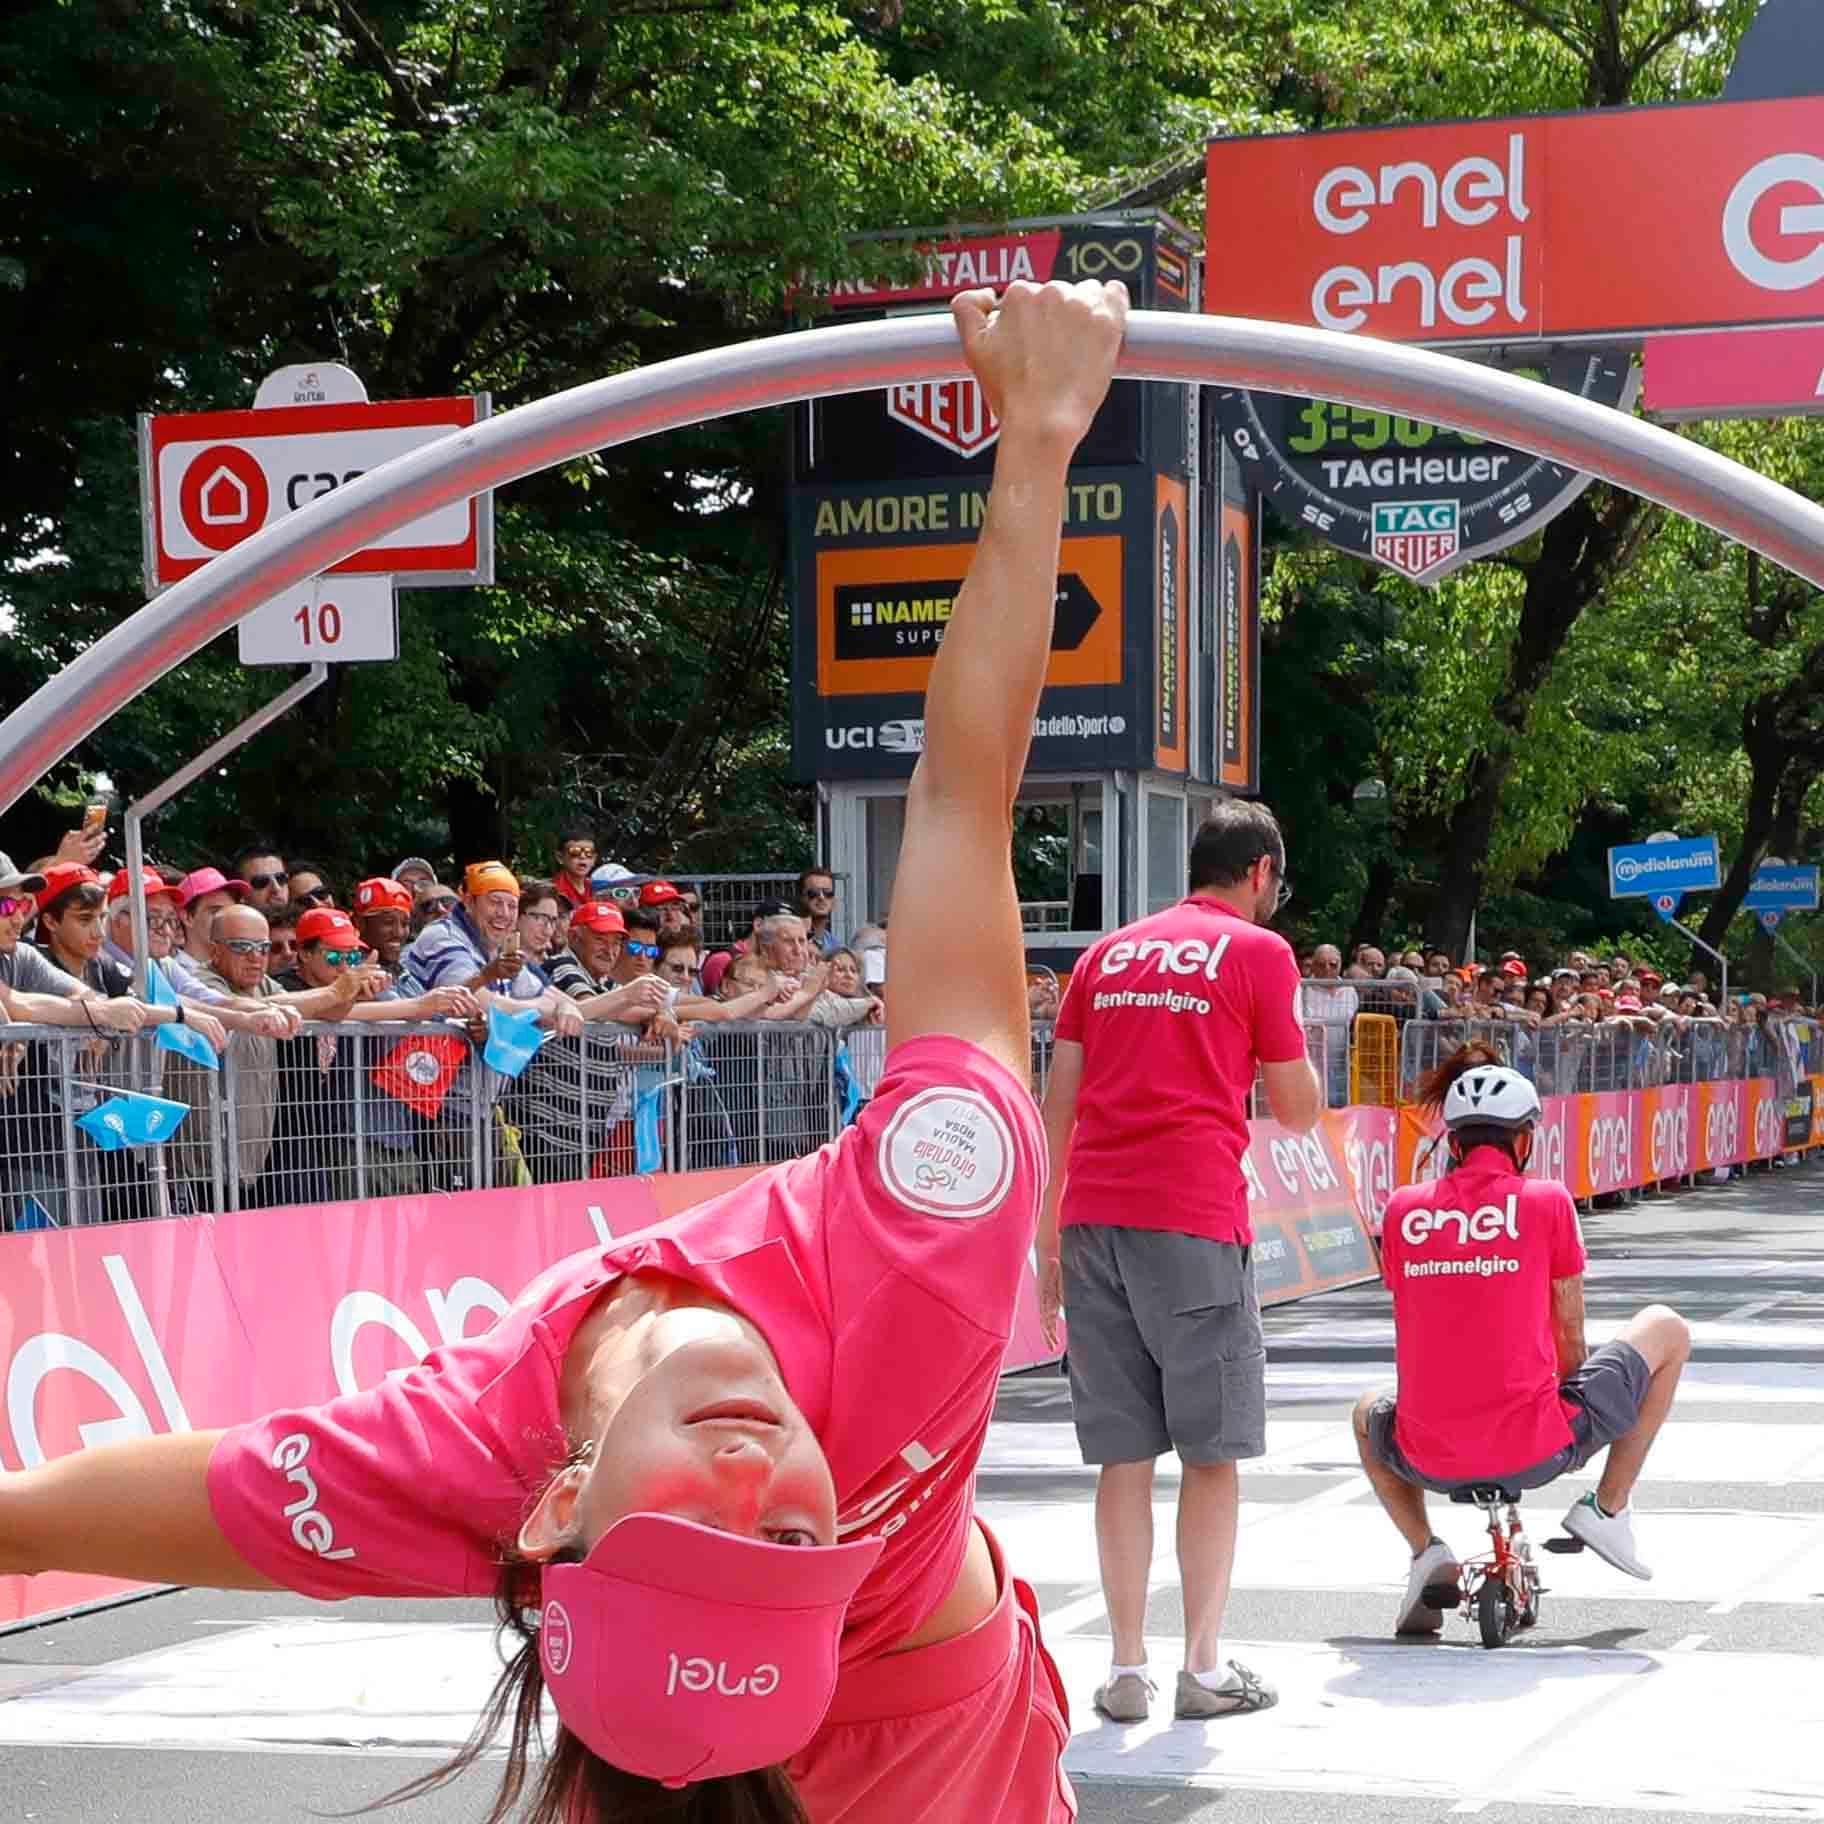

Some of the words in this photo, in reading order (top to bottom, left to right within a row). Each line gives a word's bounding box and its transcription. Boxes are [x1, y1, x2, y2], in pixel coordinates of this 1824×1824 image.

[1313, 133, 1530, 234] enel
[1312, 235, 1527, 331] enel
[898, 380, 999, 444] HEU
[287, 471, 367, 513] ca
[814, 494, 949, 537] AMORE
[960, 483, 1123, 529] INITO
[1380, 506, 1452, 531] TAG
[1377, 534, 1456, 576] HEUER
[294, 603, 342, 645] 10
[825, 726, 874, 750] UCI
[1076, 714, 1108, 738] Sport
[1101, 934, 1231, 981] enel
[933, 1128, 977, 1154] MAGLIA
[945, 1119, 976, 1139] ROSA
[1589, 1096, 1633, 1188] enel
[1706, 1084, 1739, 1163] enel
[1270, 1127, 1339, 1194] enel
[1401, 1194, 1521, 1245] enel
[272, 1433, 357, 1561] enel
[665, 1651, 781, 1697] enel
